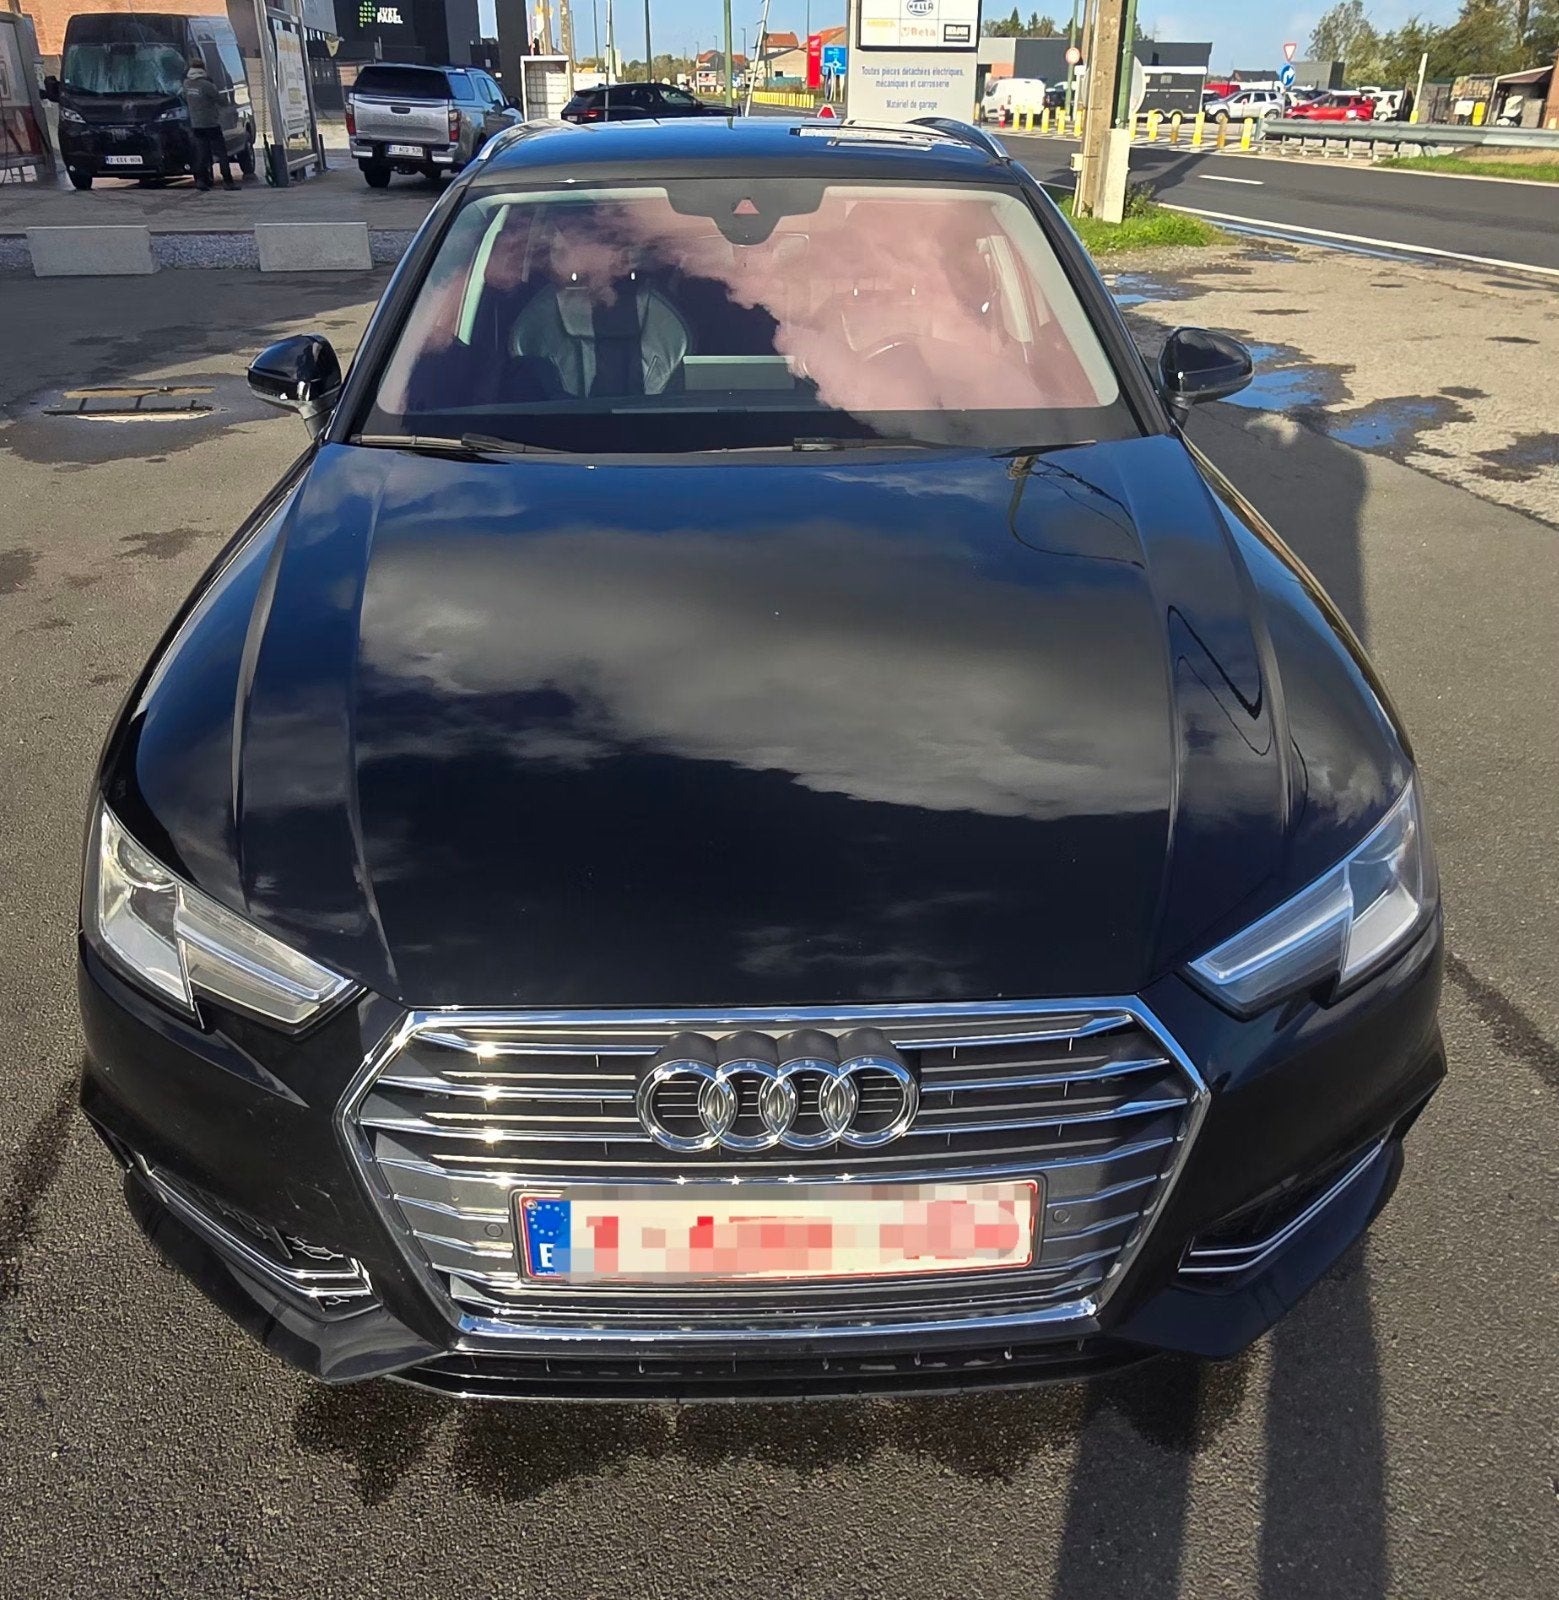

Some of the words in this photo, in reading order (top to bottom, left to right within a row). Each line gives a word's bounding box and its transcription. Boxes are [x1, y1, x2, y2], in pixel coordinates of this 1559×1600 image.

[911, 27, 936, 37] Beta
[862, 66, 880, 75] Toutes
[917, 80, 949, 88] carrosserie
[918, 101, 938, 110] garage
